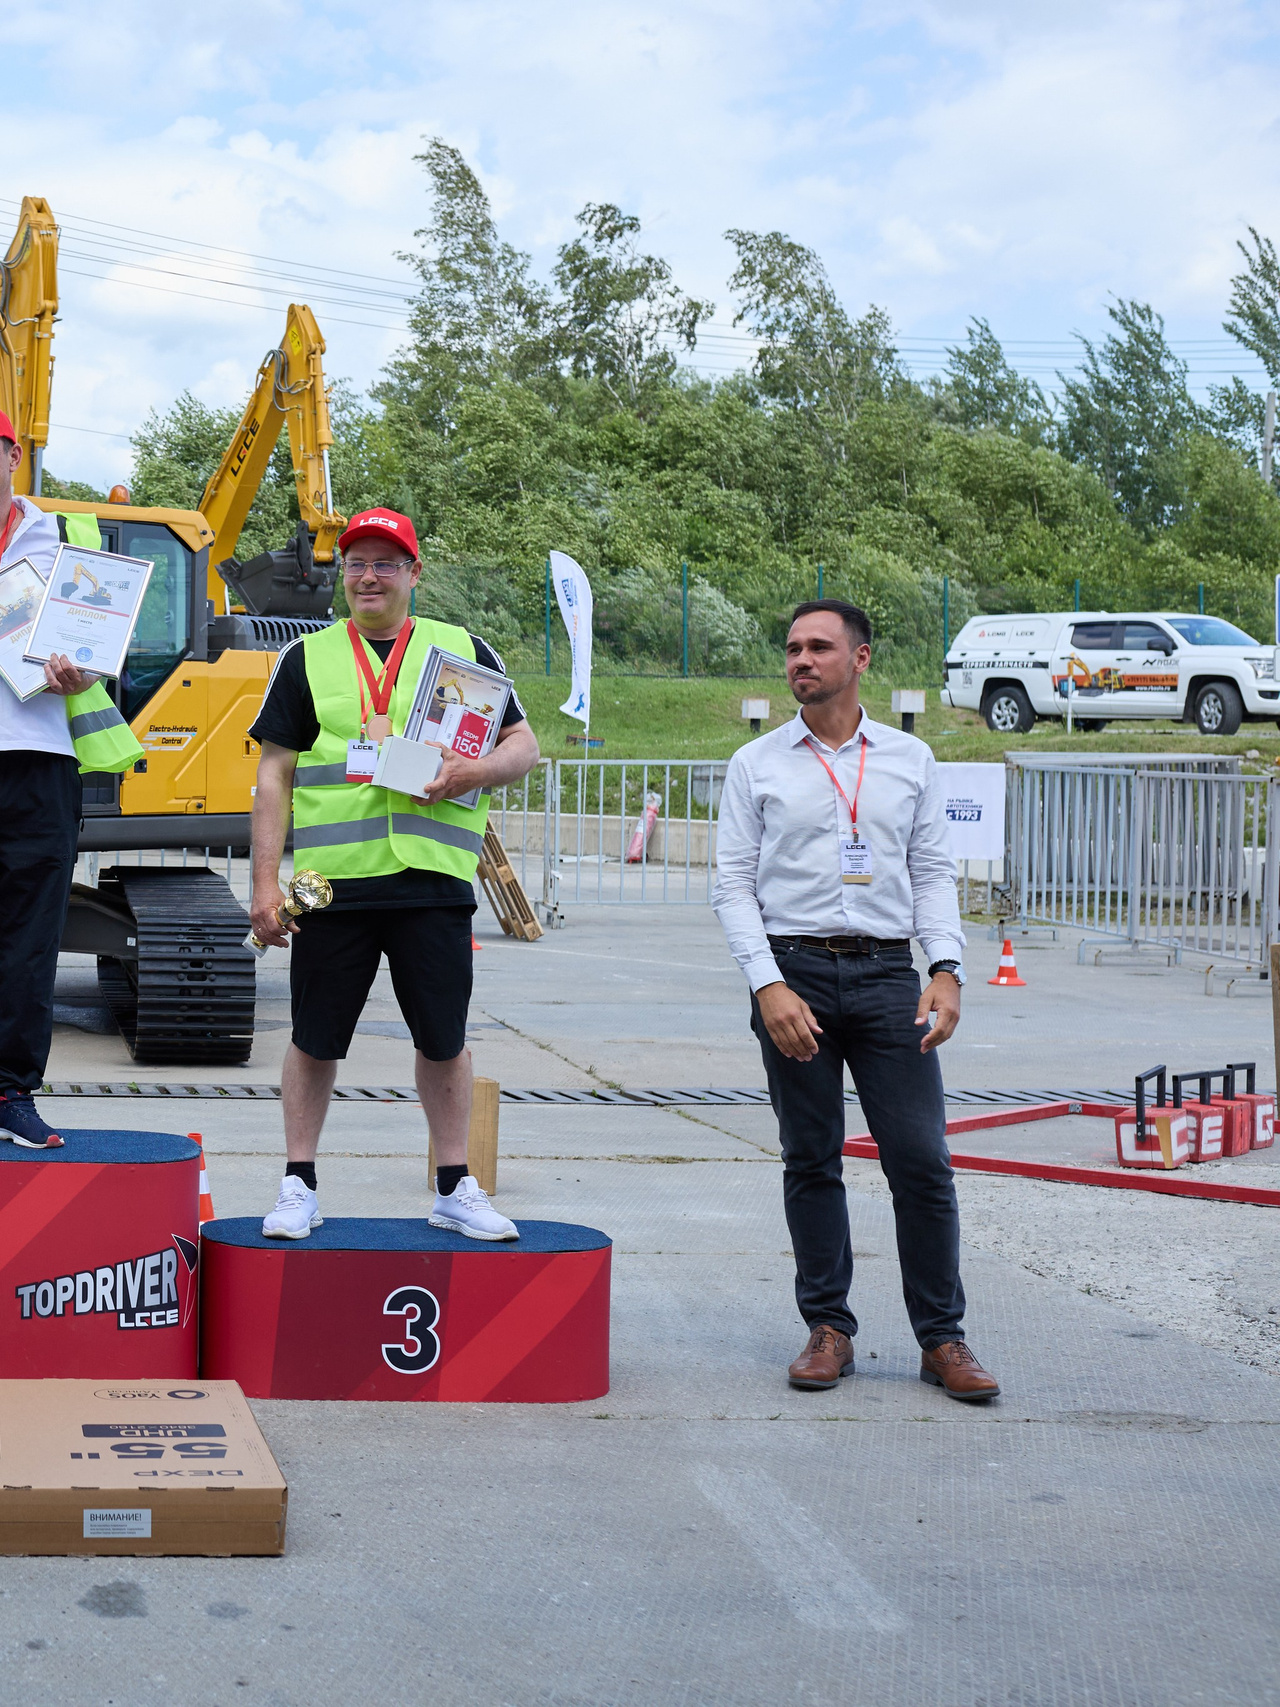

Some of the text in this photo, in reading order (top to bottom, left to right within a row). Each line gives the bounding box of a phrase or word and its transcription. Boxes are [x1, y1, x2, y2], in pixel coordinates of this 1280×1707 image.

[359, 516, 399, 530] LGCE
[67, 606, 108, 622] ДИПЛОМ
[148, 724, 198, 733] Electro-Hydraulic
[161, 737, 183, 745] Control
[455, 735, 480, 757] 15C
[954, 809, 979, 821] 1993
[16, 1246, 179, 1319] TOPDRIVER
[381, 1286, 442, 1376] 3
[89, 1513, 142, 1522] ВНИМАНИЕ!
